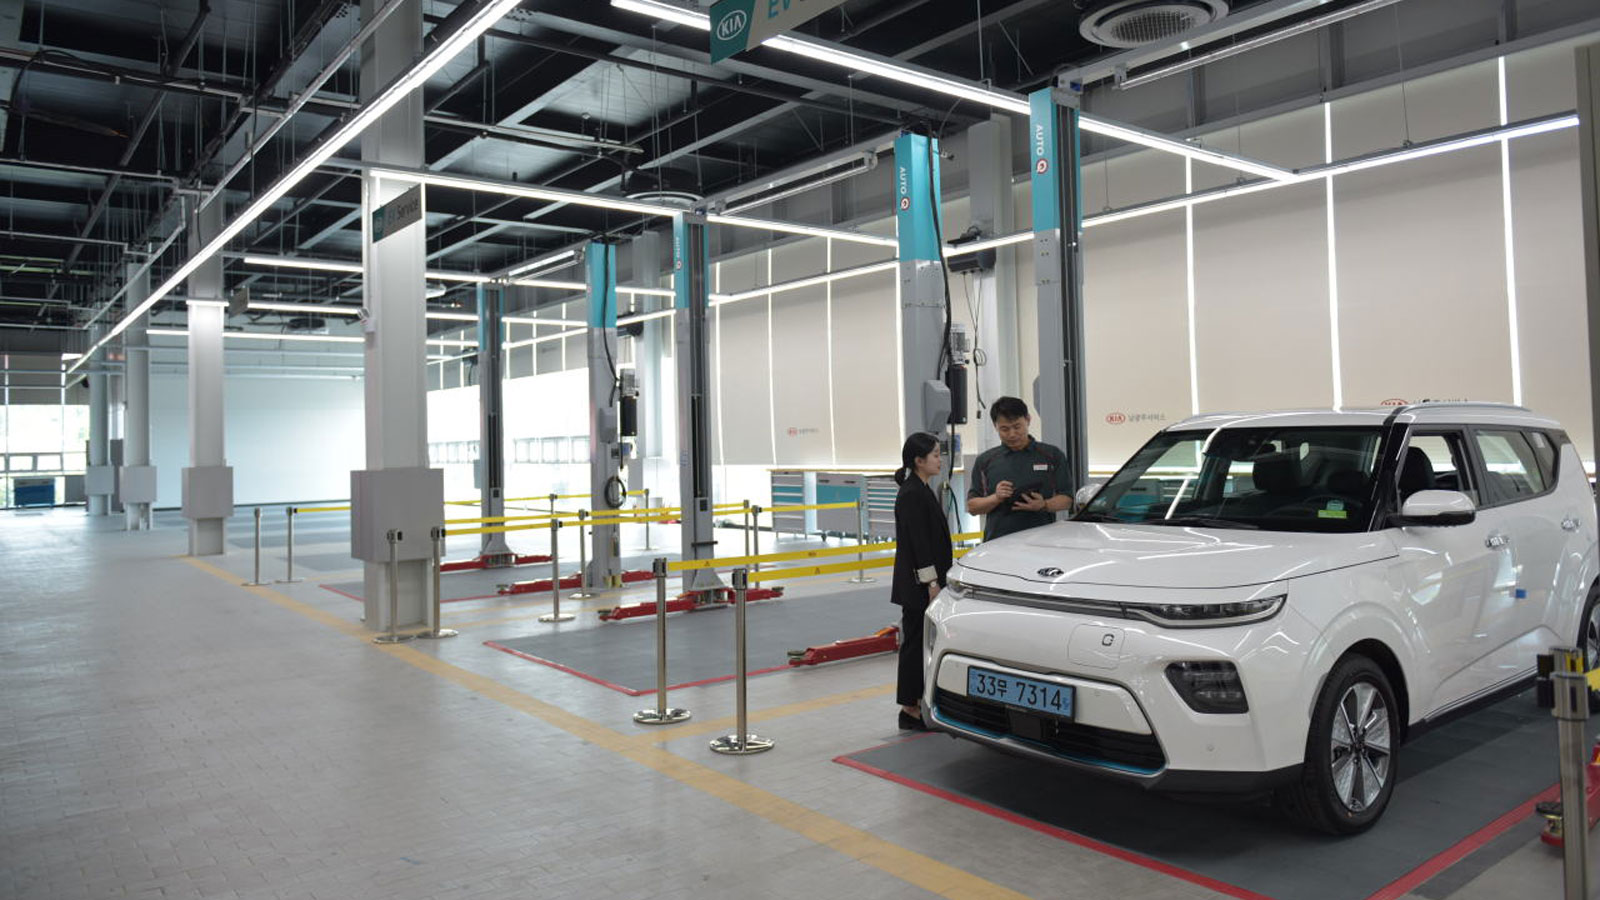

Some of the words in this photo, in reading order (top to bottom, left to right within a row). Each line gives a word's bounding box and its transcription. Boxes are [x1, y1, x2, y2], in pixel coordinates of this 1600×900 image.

[720, 14, 743, 37] KIA
[1036, 124, 1044, 156] AUTO
[899, 166, 907, 194] AUTO
[976, 674, 1007, 698] 33무
[1015, 682, 1062, 711] 7314
